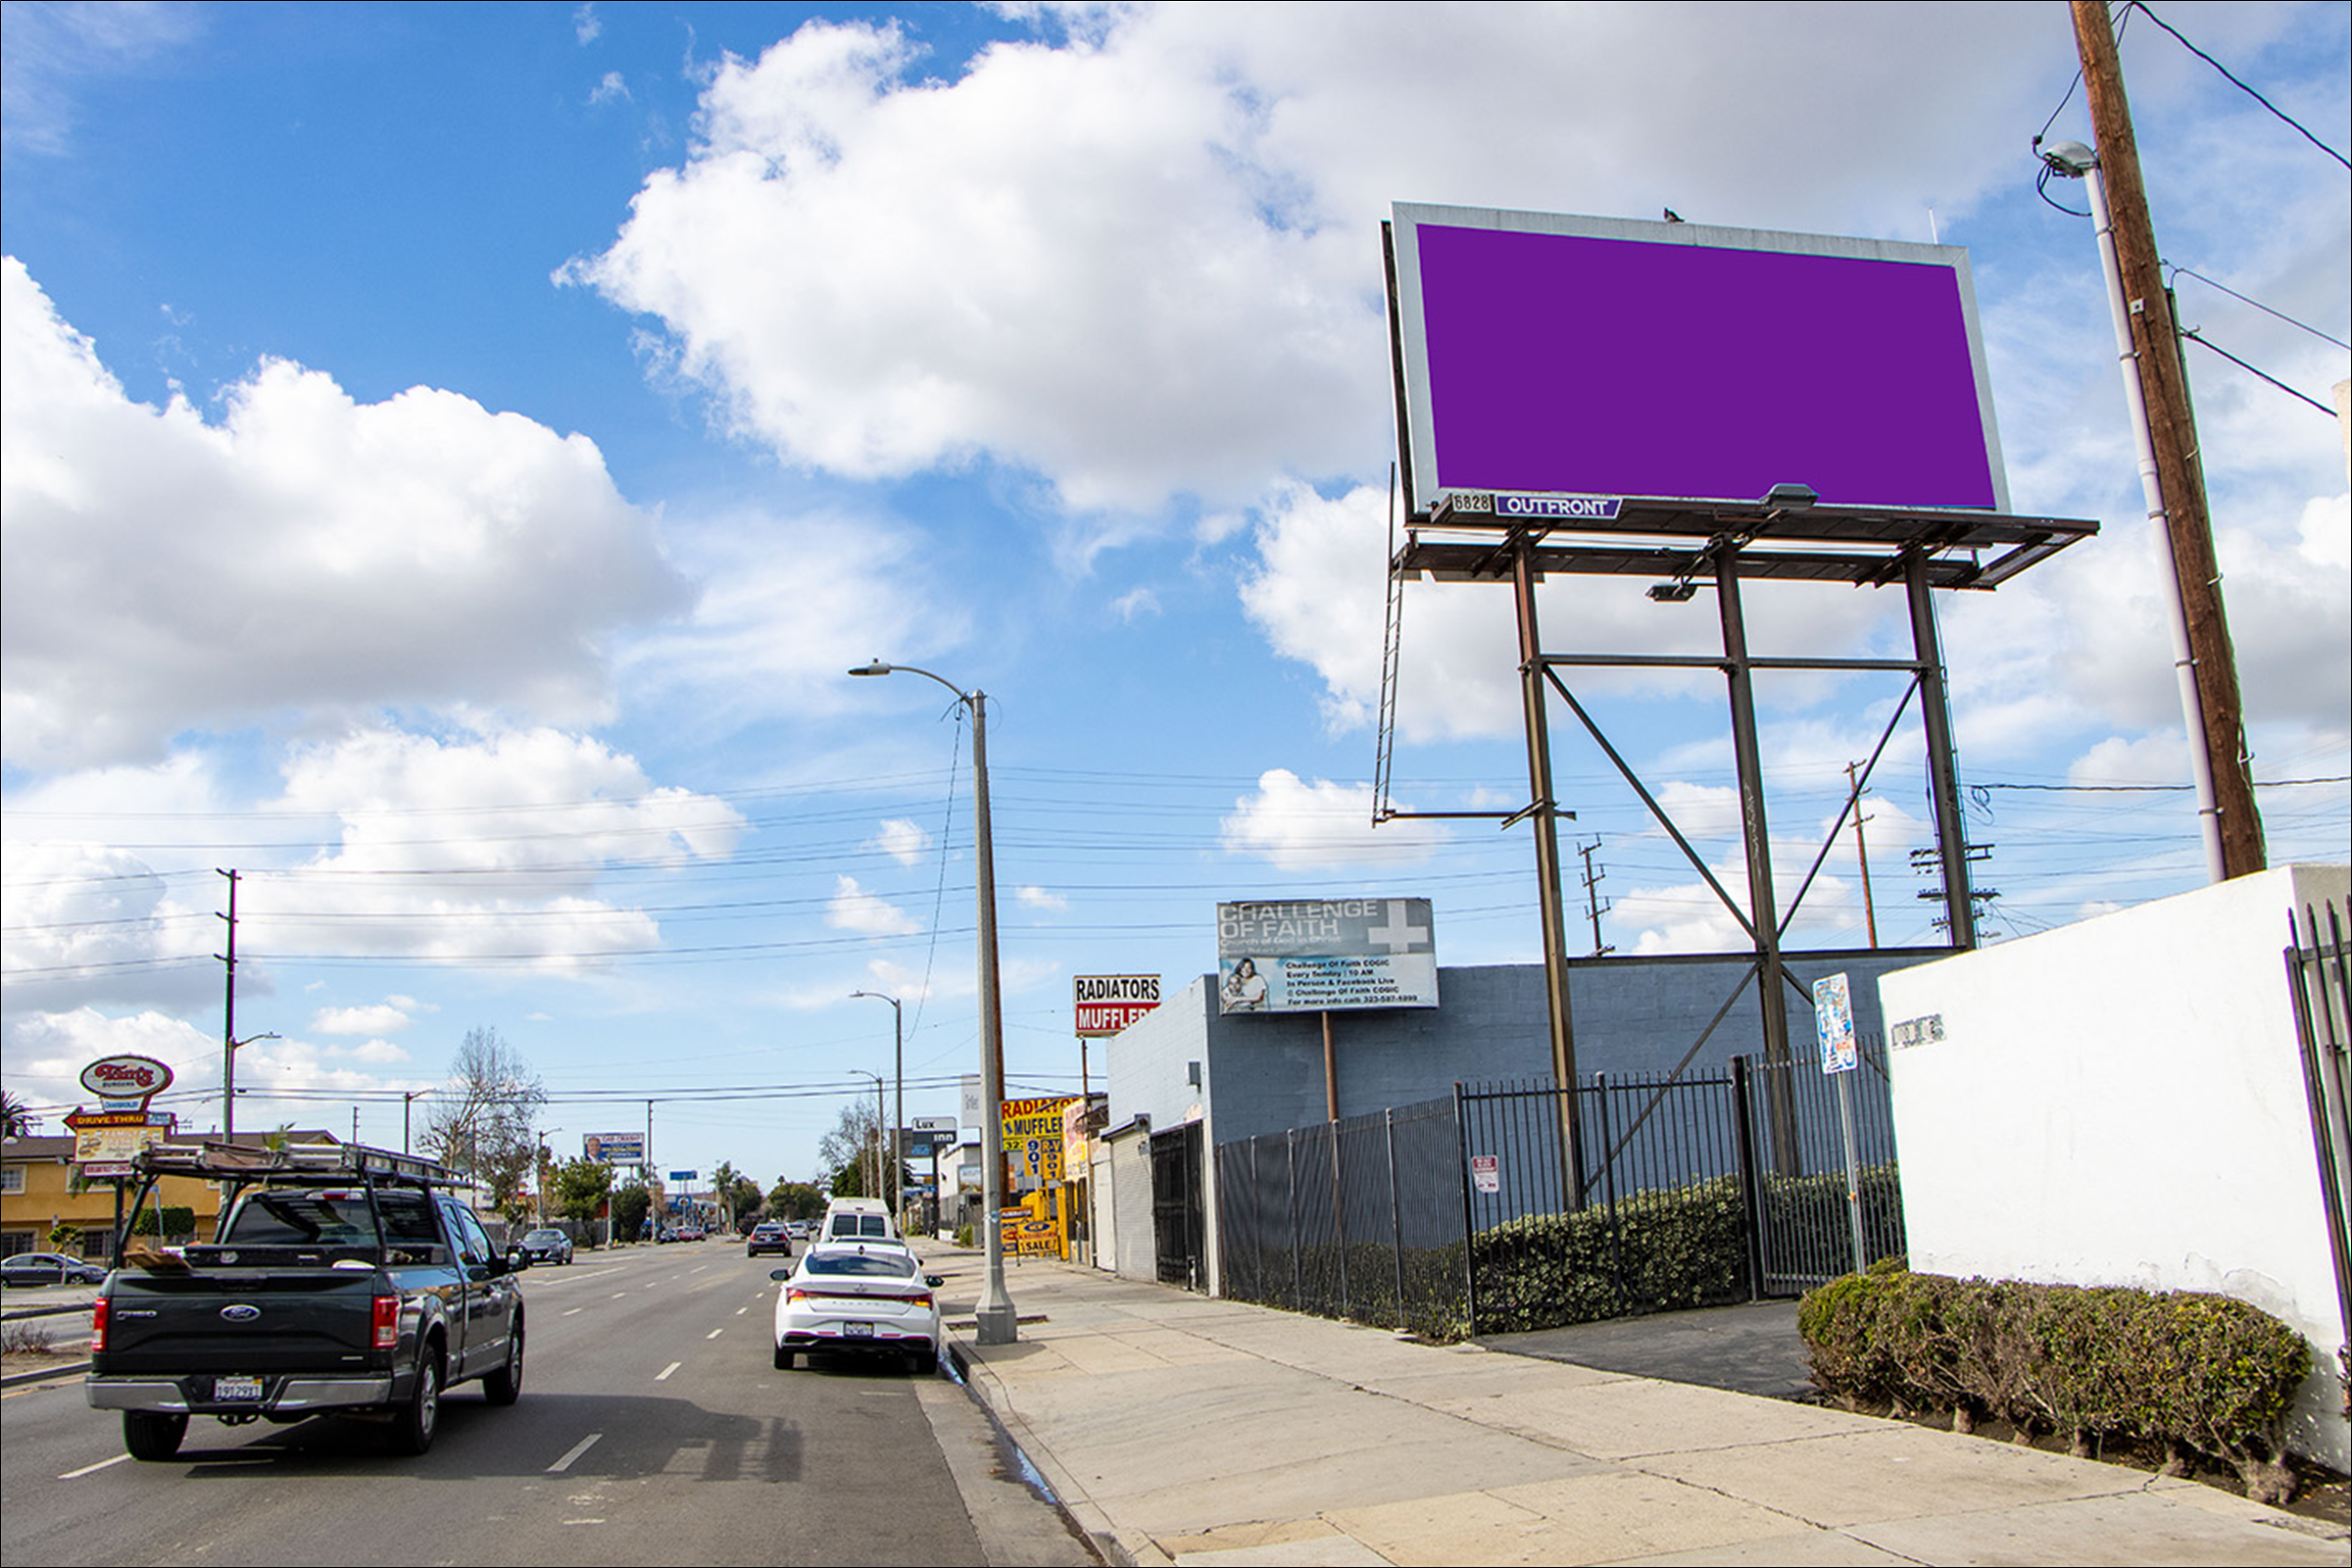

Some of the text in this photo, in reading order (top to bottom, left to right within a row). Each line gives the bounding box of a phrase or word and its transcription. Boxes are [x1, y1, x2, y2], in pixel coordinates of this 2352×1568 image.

[1454, 494, 1608, 515] 6828 OUTFRONT
[1220, 900, 1378, 922] CHALLENGE
[1220, 918, 1339, 939] OF FAITH
[1076, 978, 1160, 1001] RADIATORS
[1078, 1007, 1152, 1029] MUFFLE
[1001, 1097, 1079, 1119] RADIATO
[77, 1115, 111, 1125] DRIVE
[112, 1114, 144, 1124] THRU
[915, 1119, 936, 1129] Lux
[1005, 1140, 1024, 1152] 32
